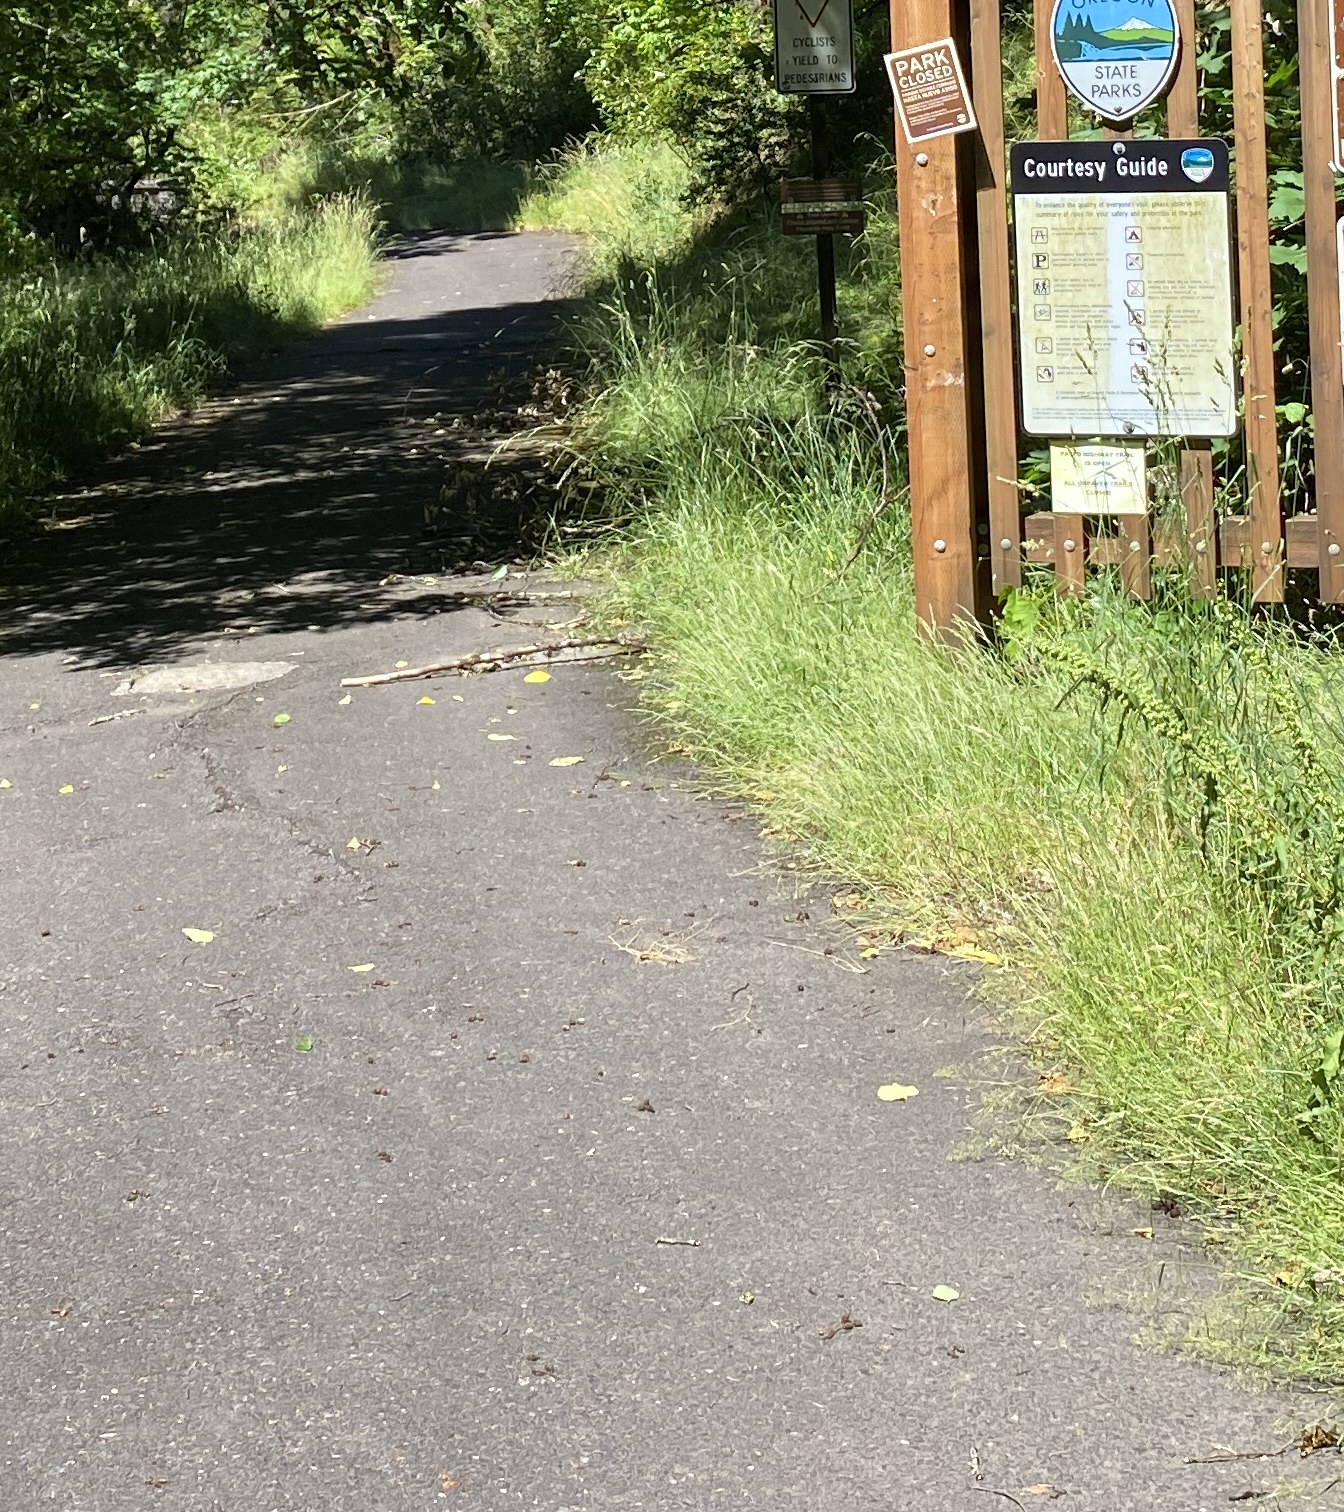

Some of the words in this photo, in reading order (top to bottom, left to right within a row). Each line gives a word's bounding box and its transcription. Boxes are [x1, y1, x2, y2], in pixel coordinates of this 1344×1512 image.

[792, 36, 836, 49] CYCLISTS
[792, 54, 819, 67] YIELD
[826, 54, 838, 66] TO
[895, 49, 949, 76] PARK
[783, 72, 847, 86] PEDESTRIANS
[899, 65, 952, 88] CLOSED
[1094, 65, 1138, 80] STATE
[1091, 83, 1142, 99] PARKS
[1024, 158, 1106, 182] Courtesy
[1116, 156, 1169, 177] Guide
